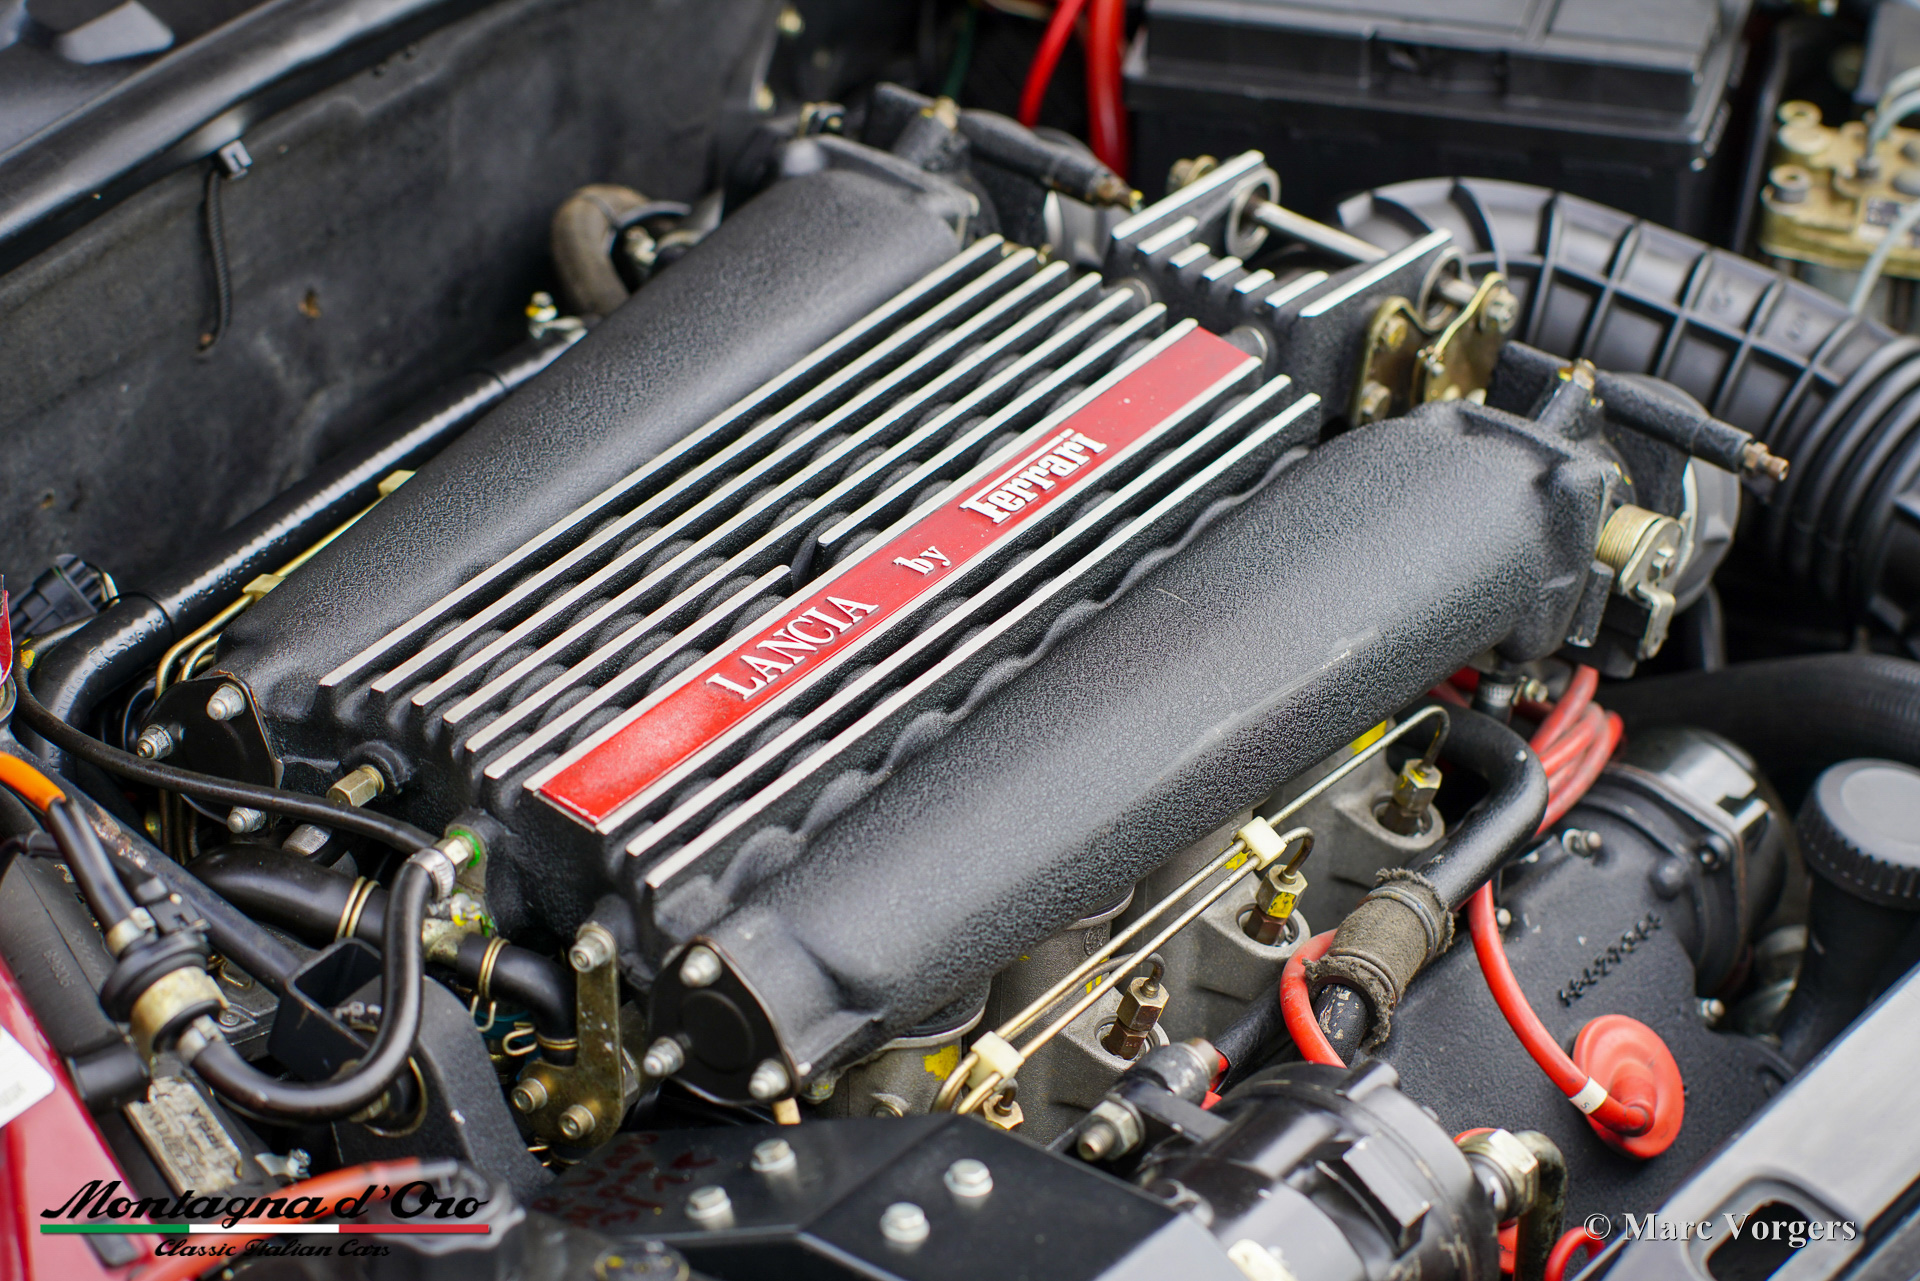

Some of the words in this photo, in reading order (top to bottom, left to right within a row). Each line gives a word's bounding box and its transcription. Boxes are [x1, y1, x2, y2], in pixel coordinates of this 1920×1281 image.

[706, 595, 879, 701] LANCIA
[892, 545, 951, 576] by
[958, 427, 1108, 524] Ferrari
